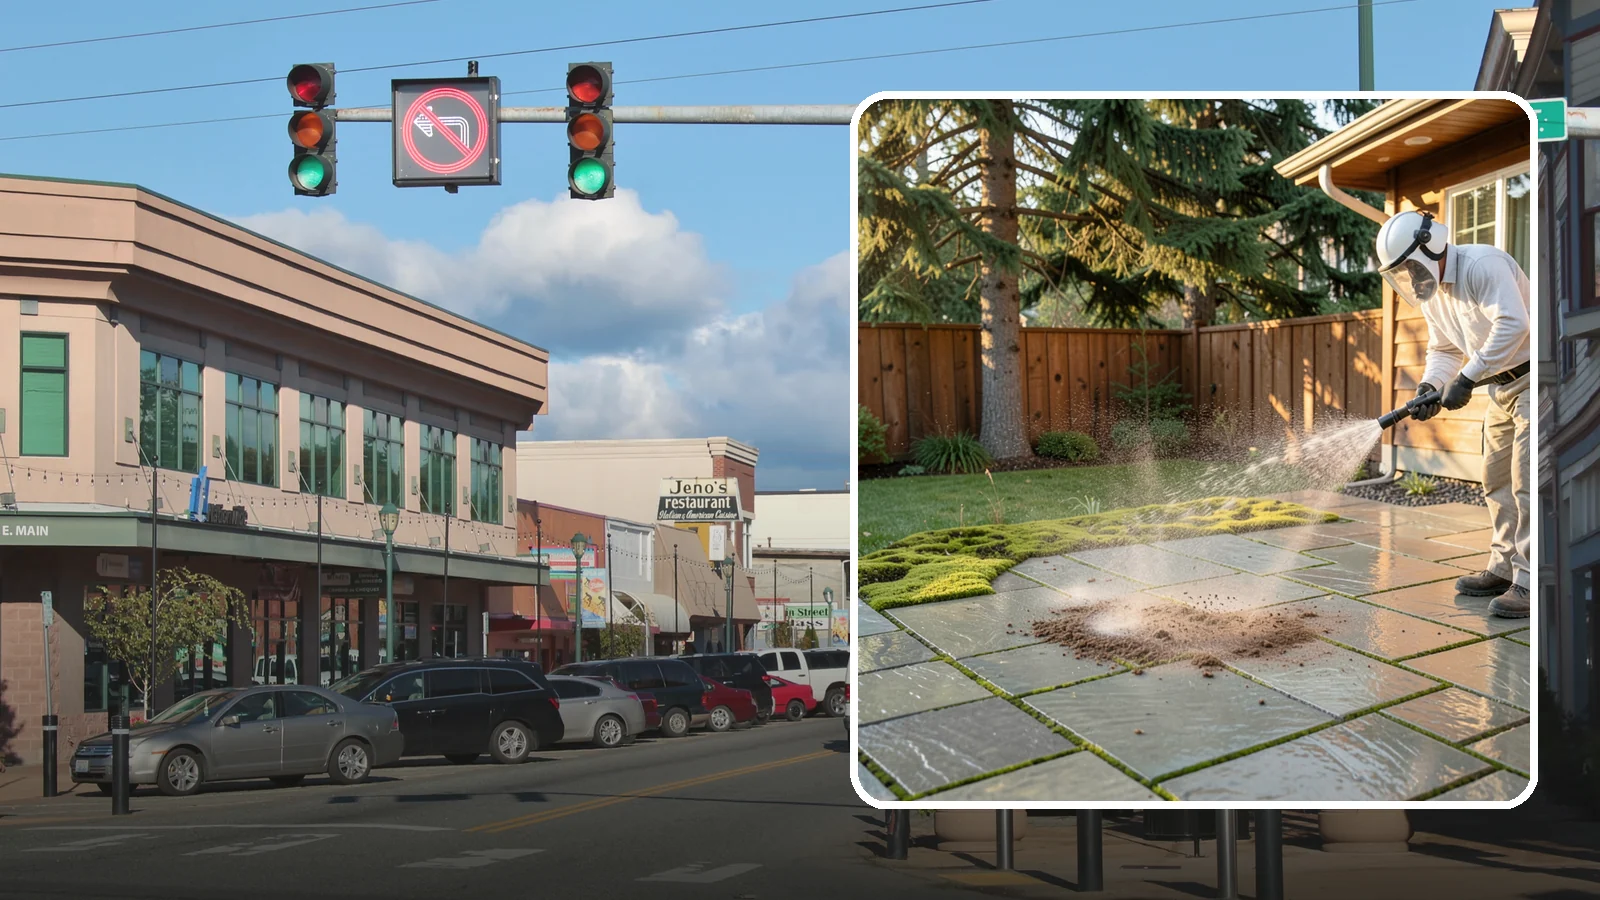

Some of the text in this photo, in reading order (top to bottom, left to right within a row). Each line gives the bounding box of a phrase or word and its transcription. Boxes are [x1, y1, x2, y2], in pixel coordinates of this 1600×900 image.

[670, 480, 728, 495] Jeno's
[665, 496, 731, 509] restaurant
[658, 509, 682, 520] Italian
[686, 509, 714, 519] American
[715, 509, 738, 519] Cuisine
[2, 525, 49, 536] E. MAIN
[785, 607, 828, 616] in Street
